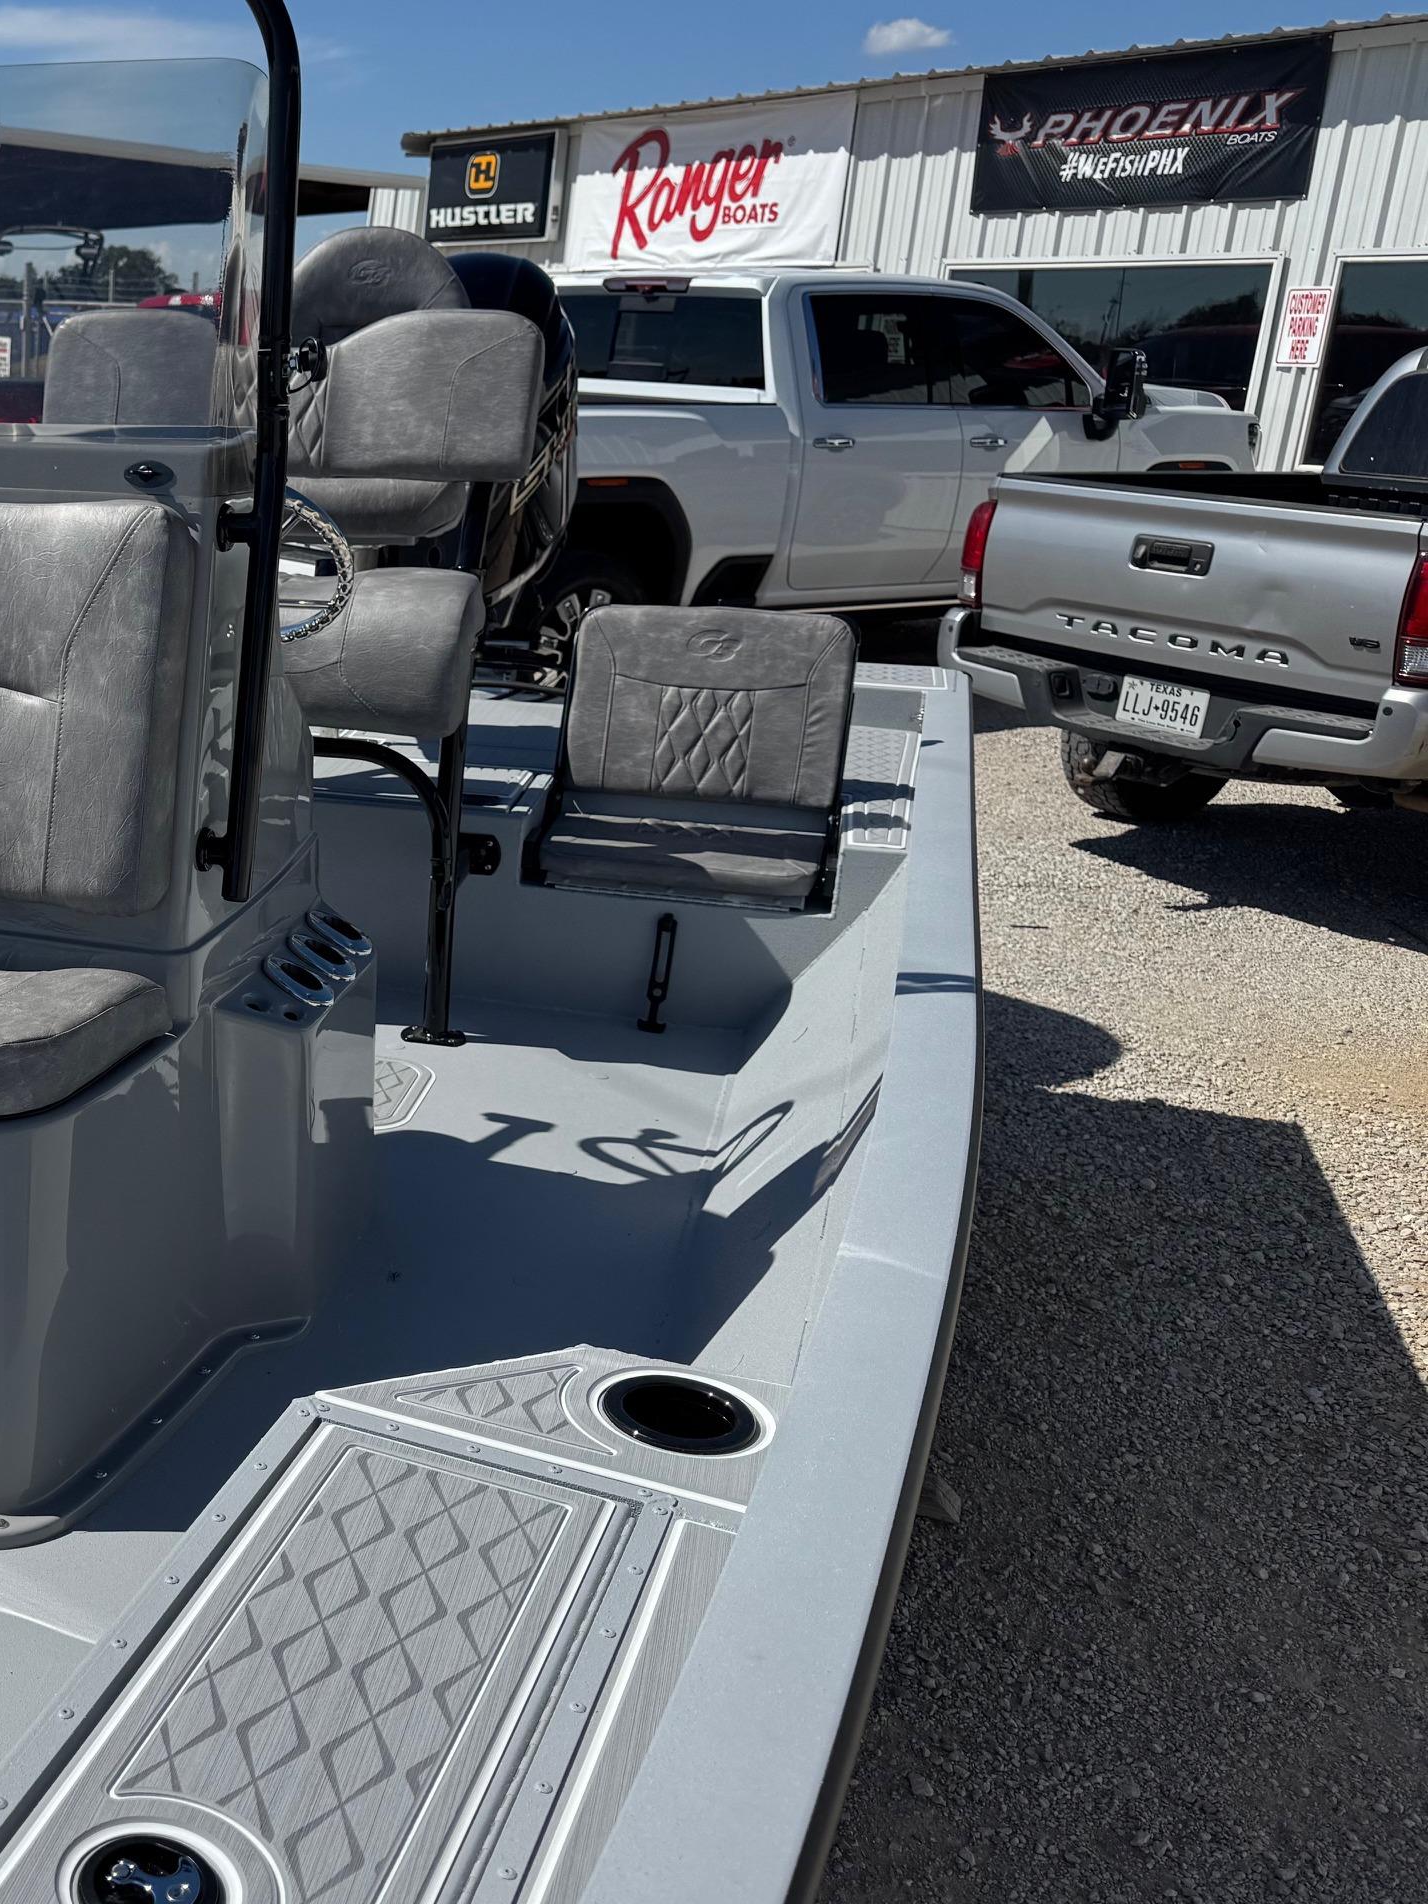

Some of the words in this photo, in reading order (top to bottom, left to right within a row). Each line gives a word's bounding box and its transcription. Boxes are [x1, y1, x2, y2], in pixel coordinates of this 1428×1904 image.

[1031, 89, 1305, 148] PHOENIX
[1227, 131, 1278, 146] BOATS
[610, 128, 784, 260] Ranger
[430, 202, 536, 229] HUSTLER
[722, 202, 779, 225] BOATS
[1289, 293, 1327, 315] CUSTOMER
[1288, 316, 1319, 338] PARKING
[1289, 339, 1309, 360] HERE
[1056, 612, 1290, 668] TACOMA
[1149, 683, 1182, 698] TEXAS
